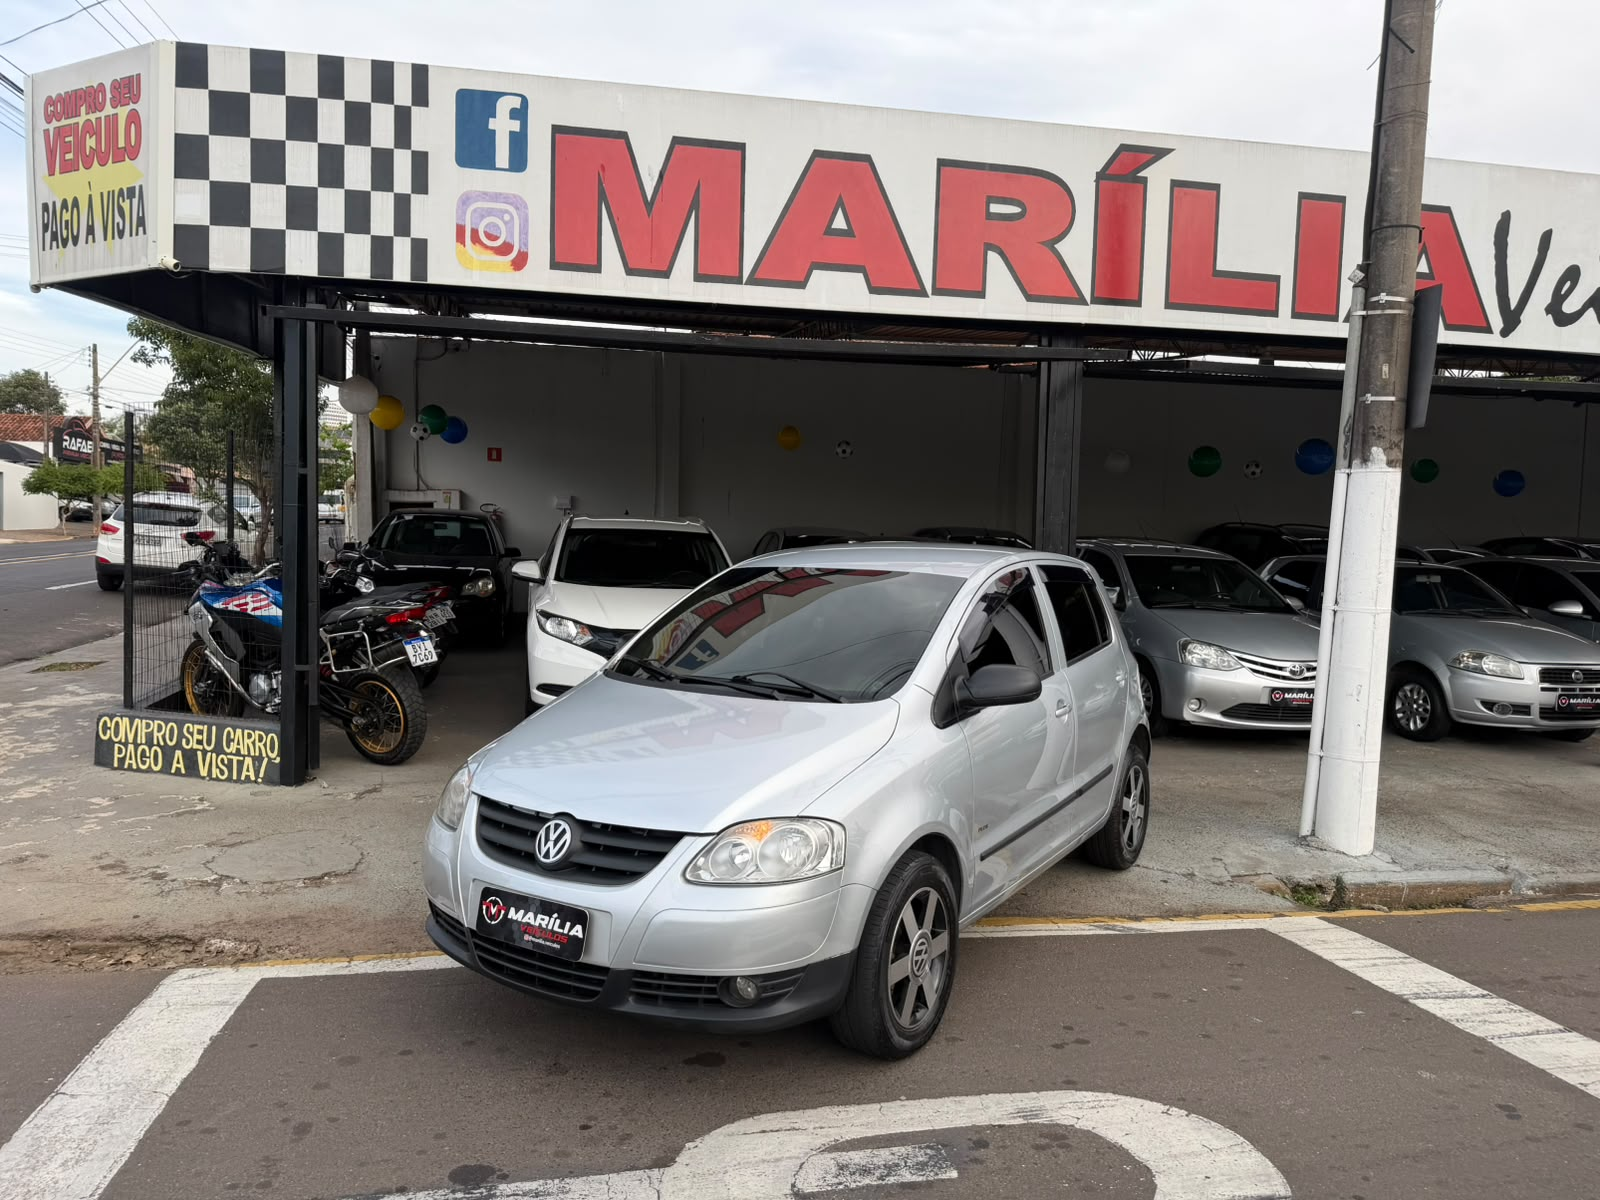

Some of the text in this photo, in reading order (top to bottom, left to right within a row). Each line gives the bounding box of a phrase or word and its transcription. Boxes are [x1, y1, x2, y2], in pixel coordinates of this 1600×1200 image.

[43, 73, 141, 125] COMPRO SEU
[43, 108, 142, 177] VEICULO
[41, 197, 80, 251] PAGO
[100, 184, 147, 242] VISTA
[1494, 209, 1600, 338] Ve
[62, 435, 94, 453] RAFAE
[1284, 691, 1314, 699] MARÍLI
[98, 716, 178, 746] COMPRO
[182, 725, 216, 751] SEU
[113, 743, 269, 783] PAGO A VISTA!
[507, 906, 583, 939] MARÍLIA
